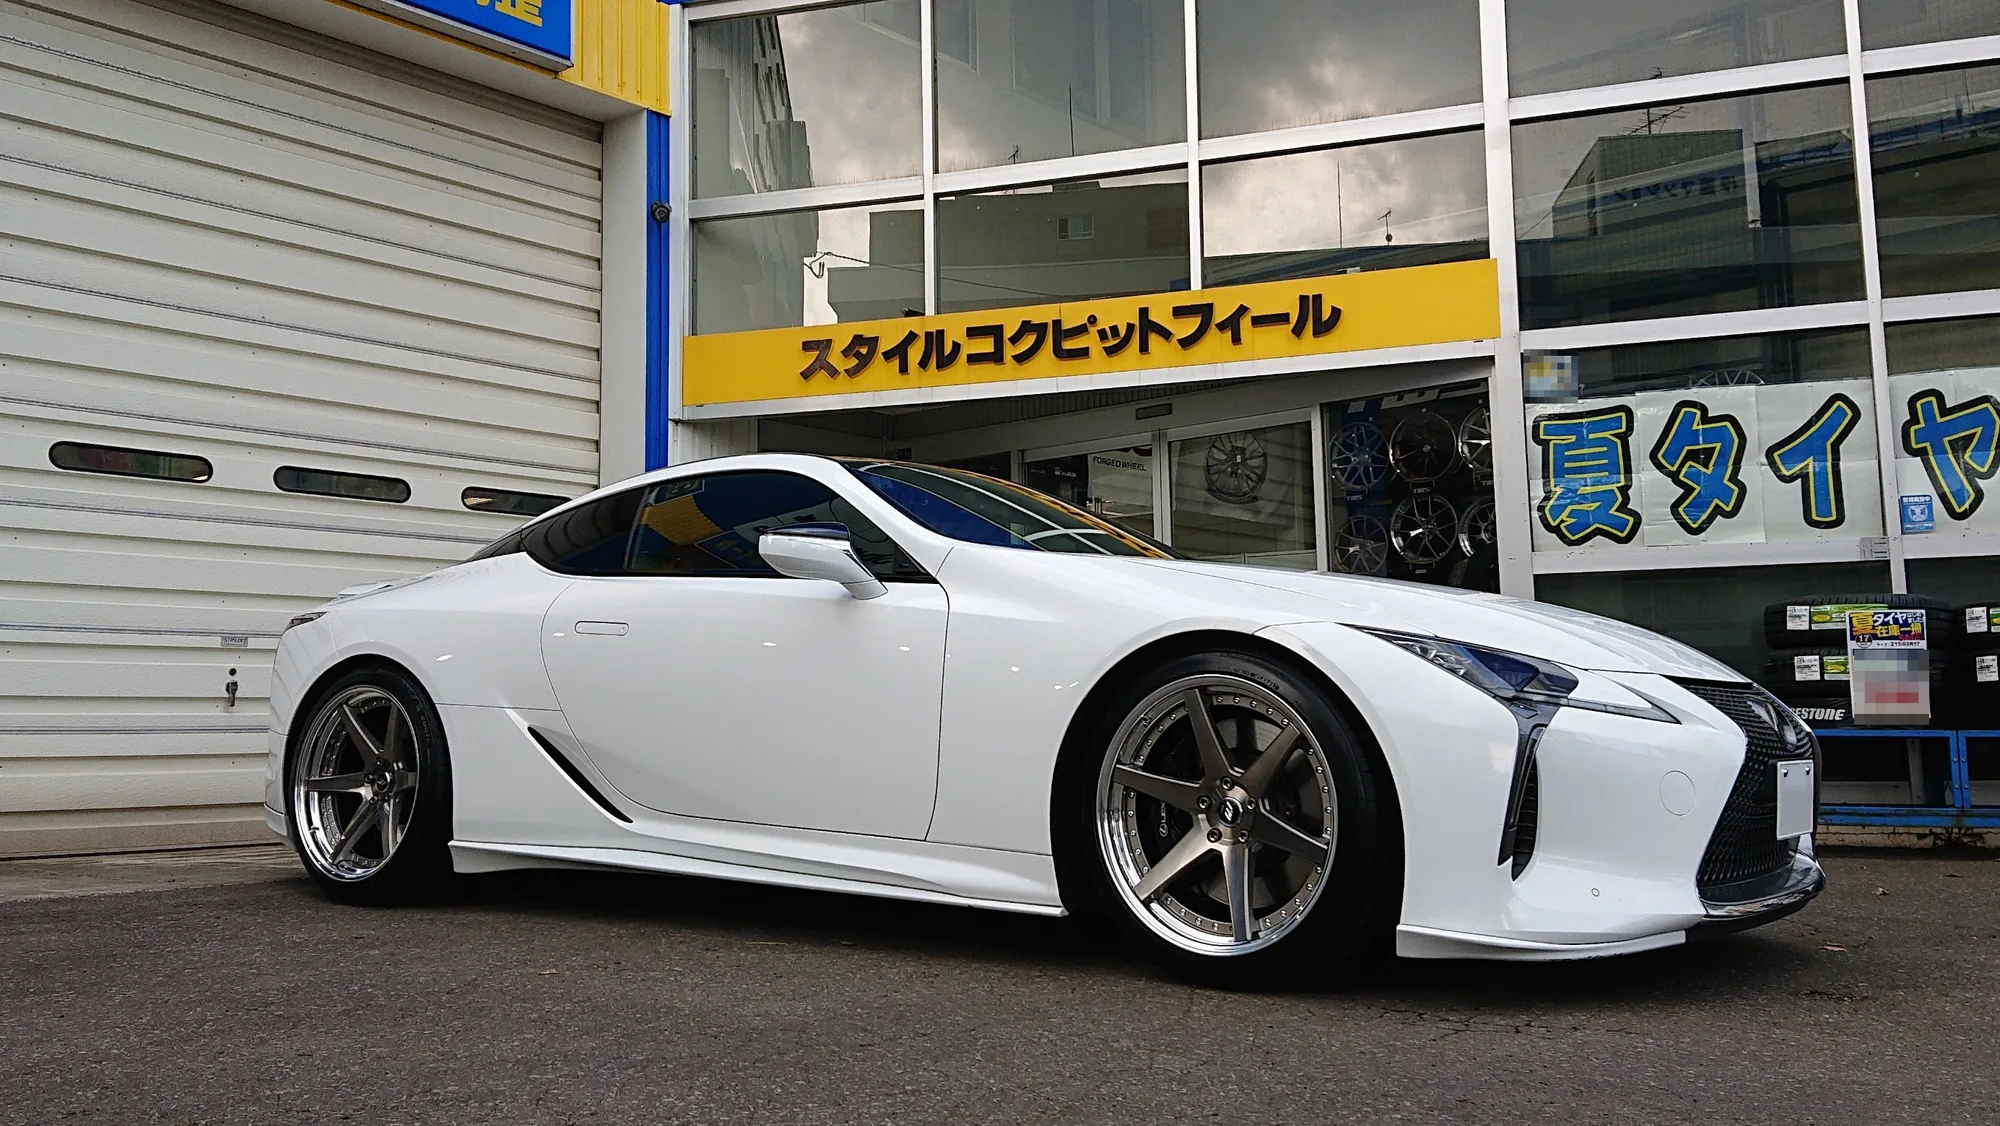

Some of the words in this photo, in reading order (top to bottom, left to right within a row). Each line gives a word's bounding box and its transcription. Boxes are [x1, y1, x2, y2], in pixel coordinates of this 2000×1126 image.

[798, 293, 1342, 381] スタイルコクピットフィール
[1092, 456, 1121, 468] FORGED
[1121, 462, 1147, 472] WHEEL
[1533, 388, 2000, 545] 夏タイヤ
[1876, 622, 1922, 637] 在庫一掃
[1859, 635, 1868, 643] 17
